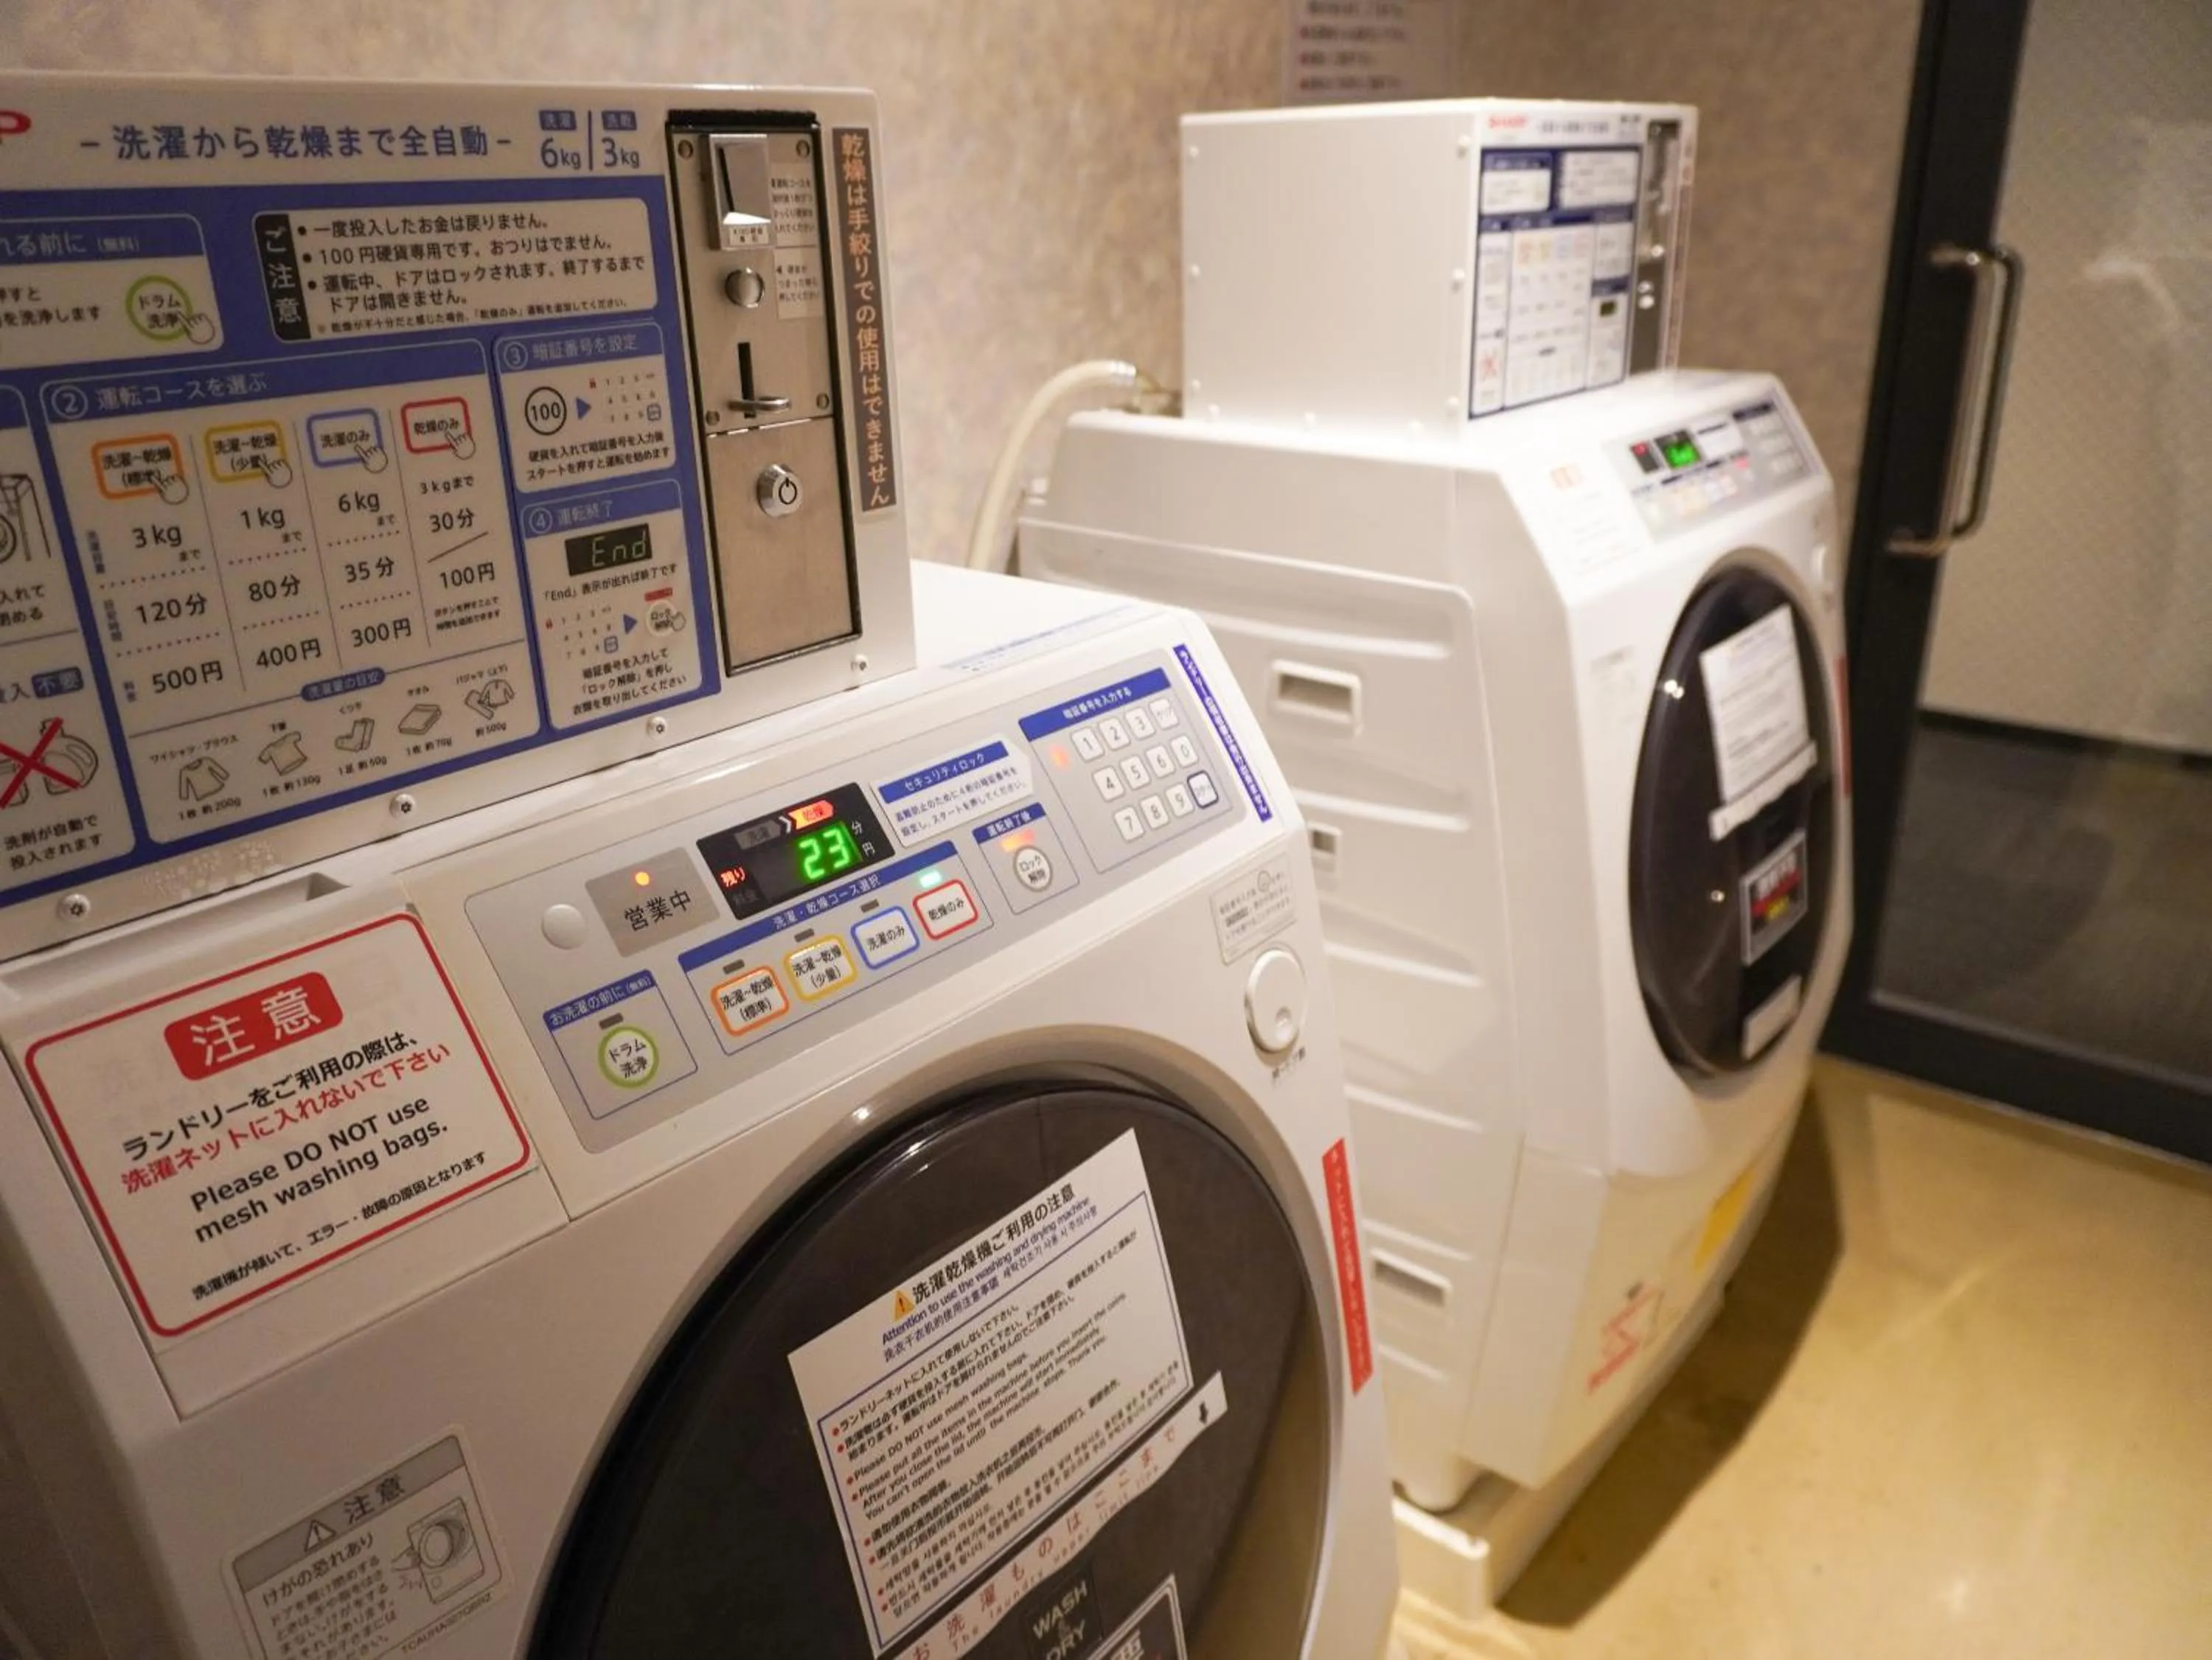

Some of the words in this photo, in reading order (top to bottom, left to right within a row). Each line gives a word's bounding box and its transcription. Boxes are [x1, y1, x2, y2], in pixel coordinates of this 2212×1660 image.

[541, 136, 581, 170] 6kg
[602, 136, 640, 169] 3kg
[265, 226, 302, 324] ご注意
[0, 306, 101, 327] を洗浄します
[139, 295, 181, 309] ドラム
[840, 133, 889, 506] 乾燥は手絞りでの使用はできません
[95, 372, 268, 411] 運転コースを選ぶ
[413, 418, 459, 436] 乾燥のみ
[531, 402, 561, 422] 100
[320, 429, 371, 449] 洗濯のみ
[338, 491, 380, 513] 6kg
[429, 507, 475, 533] 30分
[132, 524, 183, 548] 3kg
[591, 530, 647, 568] End
[344, 555, 394, 584] 35分
[439, 561, 496, 590] 100円
[248, 573, 301, 603] 80分
[136, 592, 207, 624] 120分
[351, 617, 412, 649] 300円
[256, 638, 323, 670] 400円
[152, 660, 223, 694] 500円
[1110, 725, 1120, 741] 2
[1135, 716, 1146, 730] 3
[1082, 737, 1093, 750] 1
[904, 752, 986, 791] セキュリティロック
[1130, 765, 1141, 780] 5
[1156, 755, 1166, 769] 6
[1105, 776, 1115, 789] 4
[1150, 804, 1161, 820] 8
[1175, 793, 1185, 809] 9
[4, 815, 98, 851] 洗剤が自動で
[852, 820, 863, 835] 分
[1123, 815, 1134, 832] 7
[10, 834, 102, 871] 投入されます
[799, 827, 851, 880] 23
[861, 841, 876, 857] 円
[1018, 854, 1043, 875] ロック
[624, 890, 692, 932] 営業中
[928, 897, 965, 921] 乾燥のみ
[866, 924, 906, 951] 洗濯のみ
[549, 986, 625, 1026] お洗濯の前に
[189, 984, 322, 1067] 注意
[609, 1039, 647, 1064] ドラム
[619, 1056, 649, 1078] 洗浄
[122, 1030, 417, 1162] ランドリーをご利用の際は、
[121, 1043, 451, 1195] 洗濯ネットに入れないで下さい
[189, 1164, 280, 1213] Please
[285, 1140, 323, 1172] DO
[329, 1116, 380, 1154] NOT
[387, 1096, 431, 1127] use
[195, 1196, 269, 1244] mesh
[276, 1147, 380, 1207] washing
[386, 1122, 448, 1159] bags.
[911, 1181, 1074, 1305] 洗濯乾燥機ご利用の注意
[881, 1306, 926, 1347] Attention
[928, 1298, 939, 1315] to
[939, 1286, 956, 1307] use
[958, 1274, 974, 1294] the
[975, 1249, 1011, 1283] washing
[1012, 1237, 1029, 1258] and
[1029, 1217, 1056, 1245] drying
[1057, 1195, 1089, 1226] machine
[854, 1451, 886, 1483] Please
[888, 1440, 902, 1458] DO
[905, 1423, 924, 1445] NOT
[927, 1412, 943, 1430] use
[945, 1392, 968, 1417] mesh
[970, 1365, 1005, 1399] washing
[1006, 1349, 1028, 1373] bags.
[344, 1474, 406, 1524] 注意
[1032, 1580, 1088, 1640] WASH
